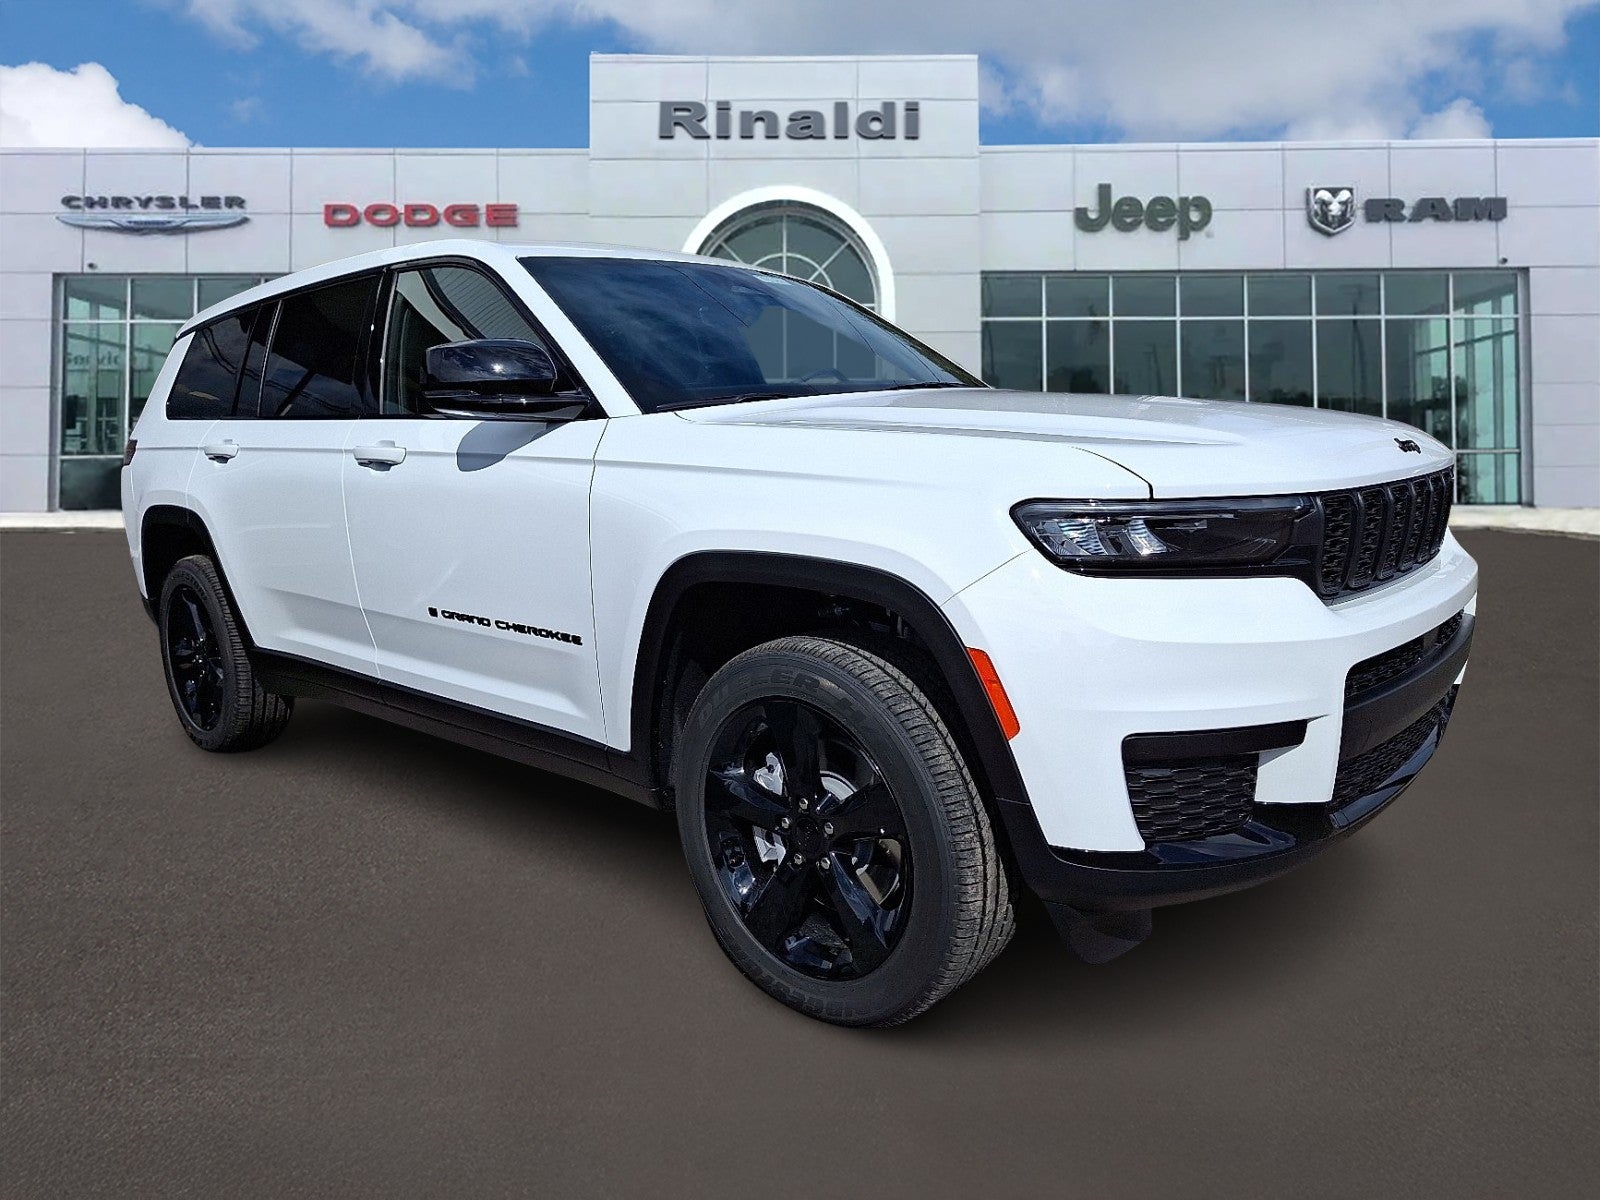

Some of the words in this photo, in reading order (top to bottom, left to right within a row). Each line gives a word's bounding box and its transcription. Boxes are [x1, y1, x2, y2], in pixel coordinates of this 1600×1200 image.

[658, 100, 920, 141] Rinaldi
[61, 195, 246, 209] CHRYSLER
[324, 203, 519, 228] DODGE
[1074, 183, 1213, 241] Jeep
[1364, 197, 1508, 223] RAM
[441, 609, 491, 628] GRAND
[494, 620, 583, 646] CHEROKEE
